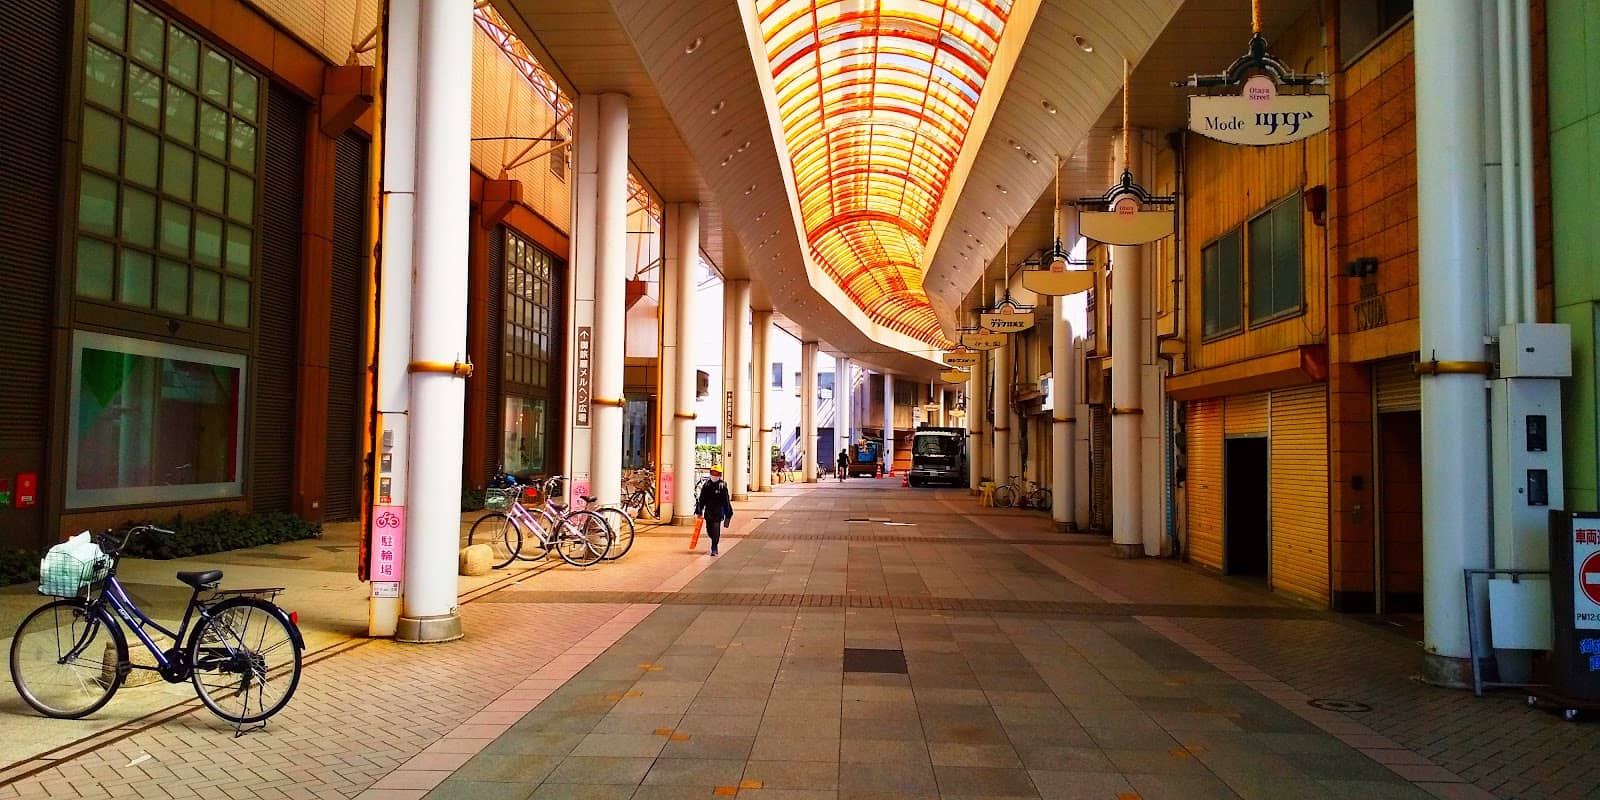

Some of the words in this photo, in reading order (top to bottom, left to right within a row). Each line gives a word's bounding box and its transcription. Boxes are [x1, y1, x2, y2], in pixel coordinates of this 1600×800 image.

[1204, 116, 1245, 131] Mode
[380, 535, 393, 576] 駐輪場
